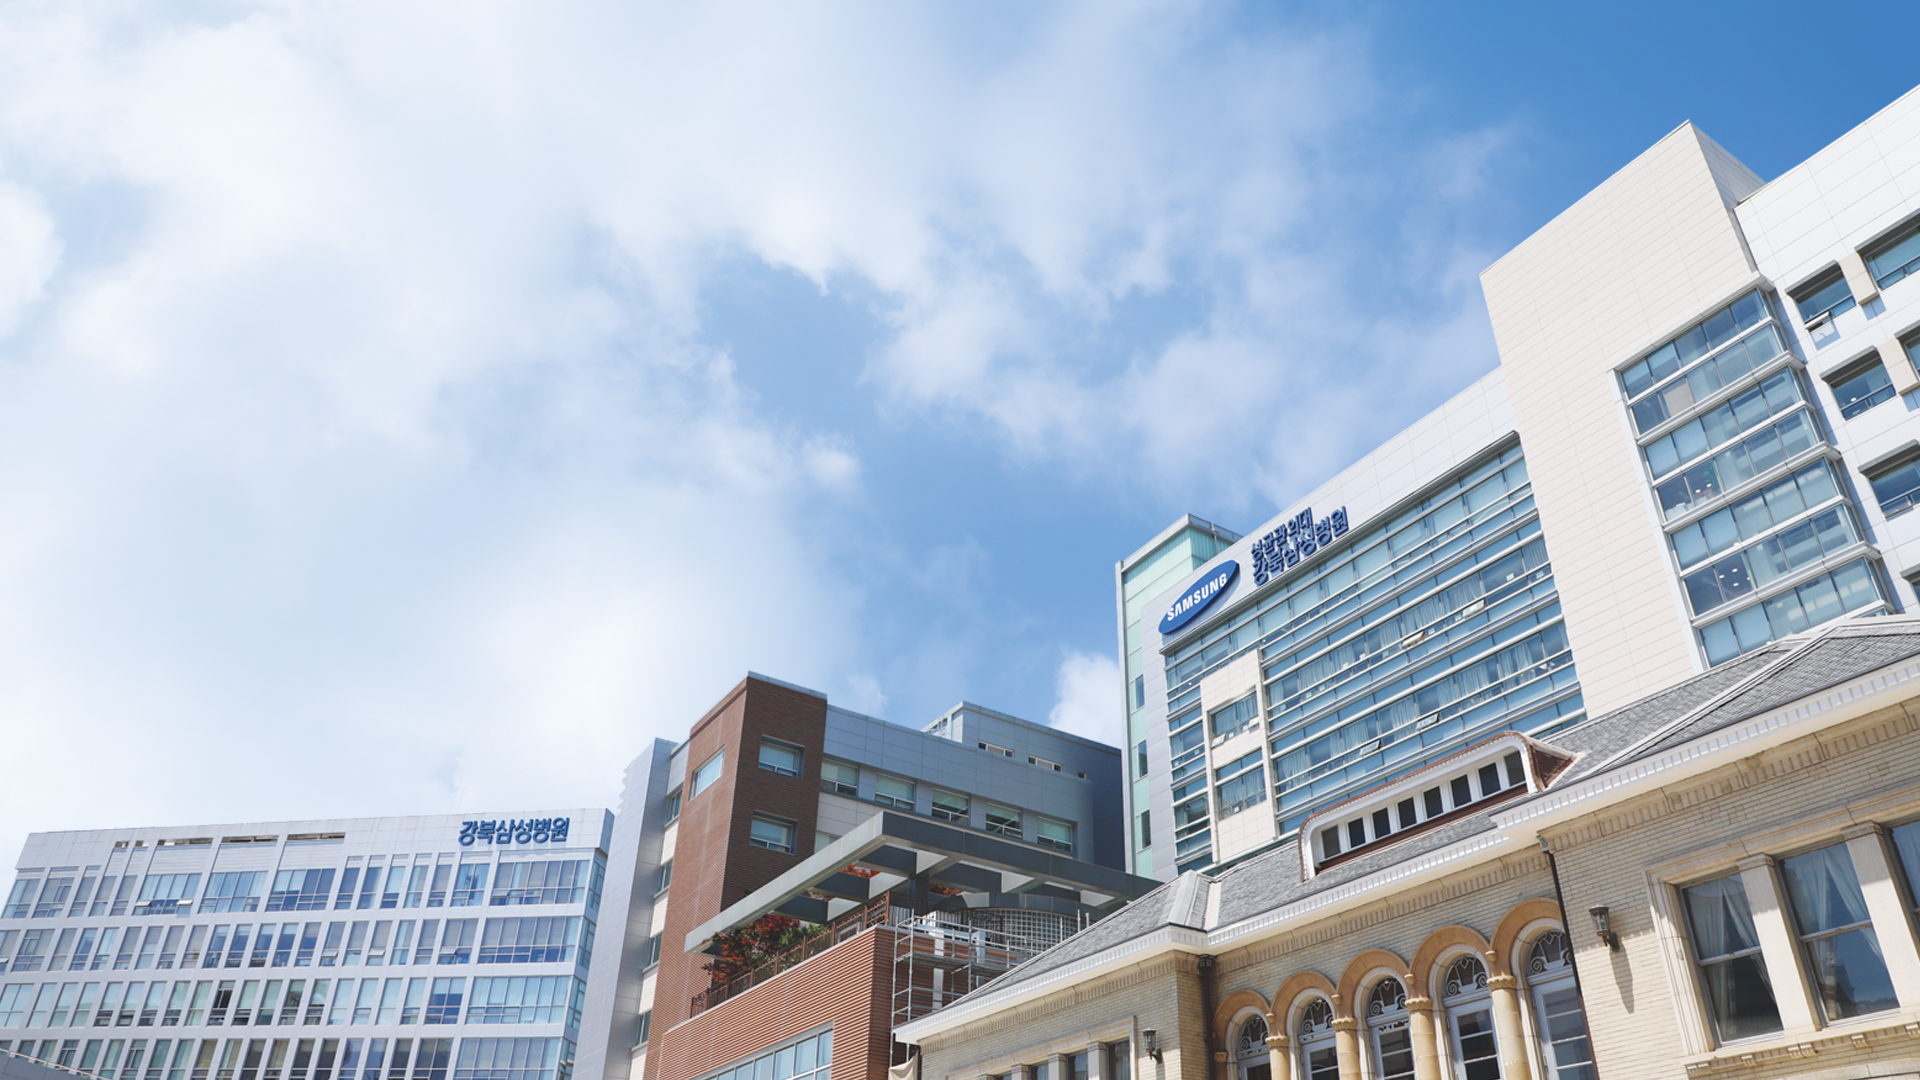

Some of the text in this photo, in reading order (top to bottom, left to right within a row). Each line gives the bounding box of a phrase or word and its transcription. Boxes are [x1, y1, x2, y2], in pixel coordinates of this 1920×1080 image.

[1252, 505, 1349, 586] 강북삼성병원
[1167, 573, 1227, 621] SAMSUNG
[458, 817, 570, 846] 강북삼성병원
